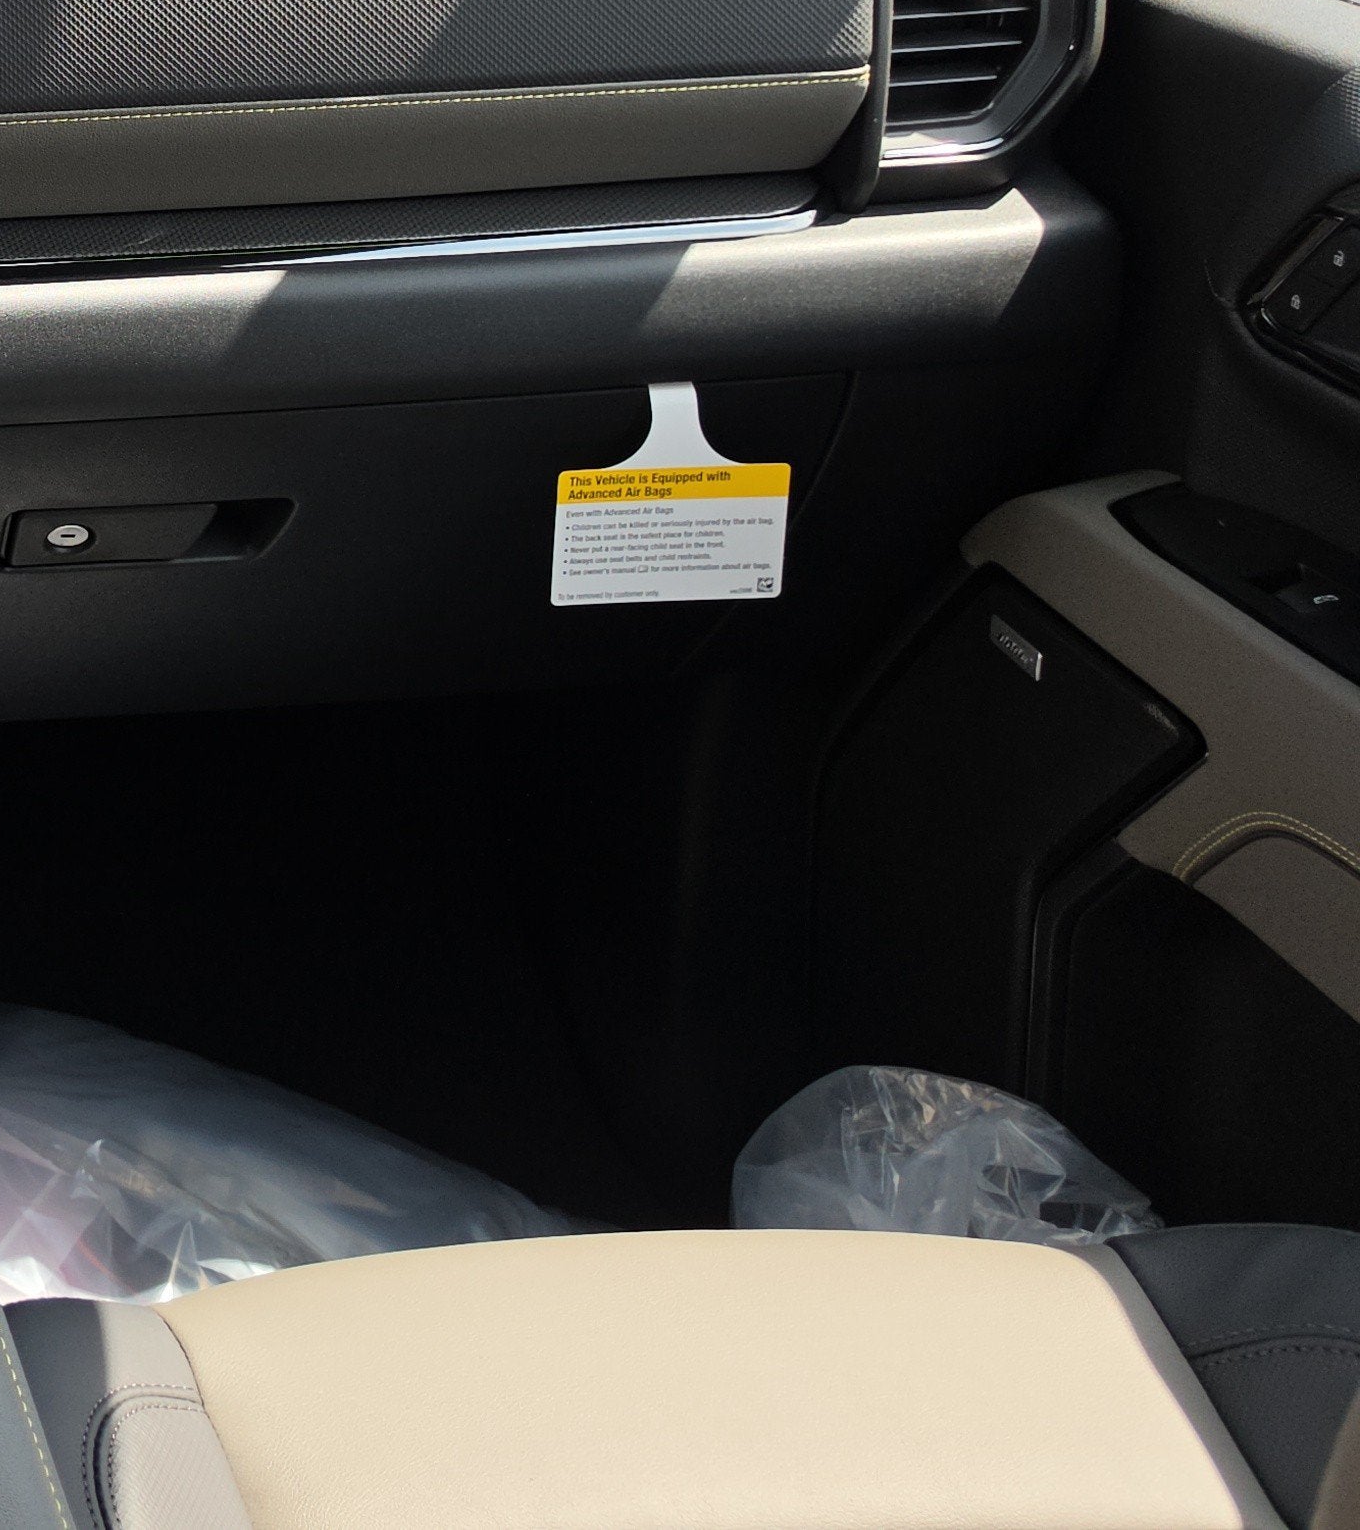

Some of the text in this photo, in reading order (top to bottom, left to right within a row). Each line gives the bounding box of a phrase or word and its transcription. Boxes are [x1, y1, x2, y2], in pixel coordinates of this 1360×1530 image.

[570, 471, 731, 486] This Vehicle is Equipped with
[568, 486, 672, 500] Advanced Air Bags
